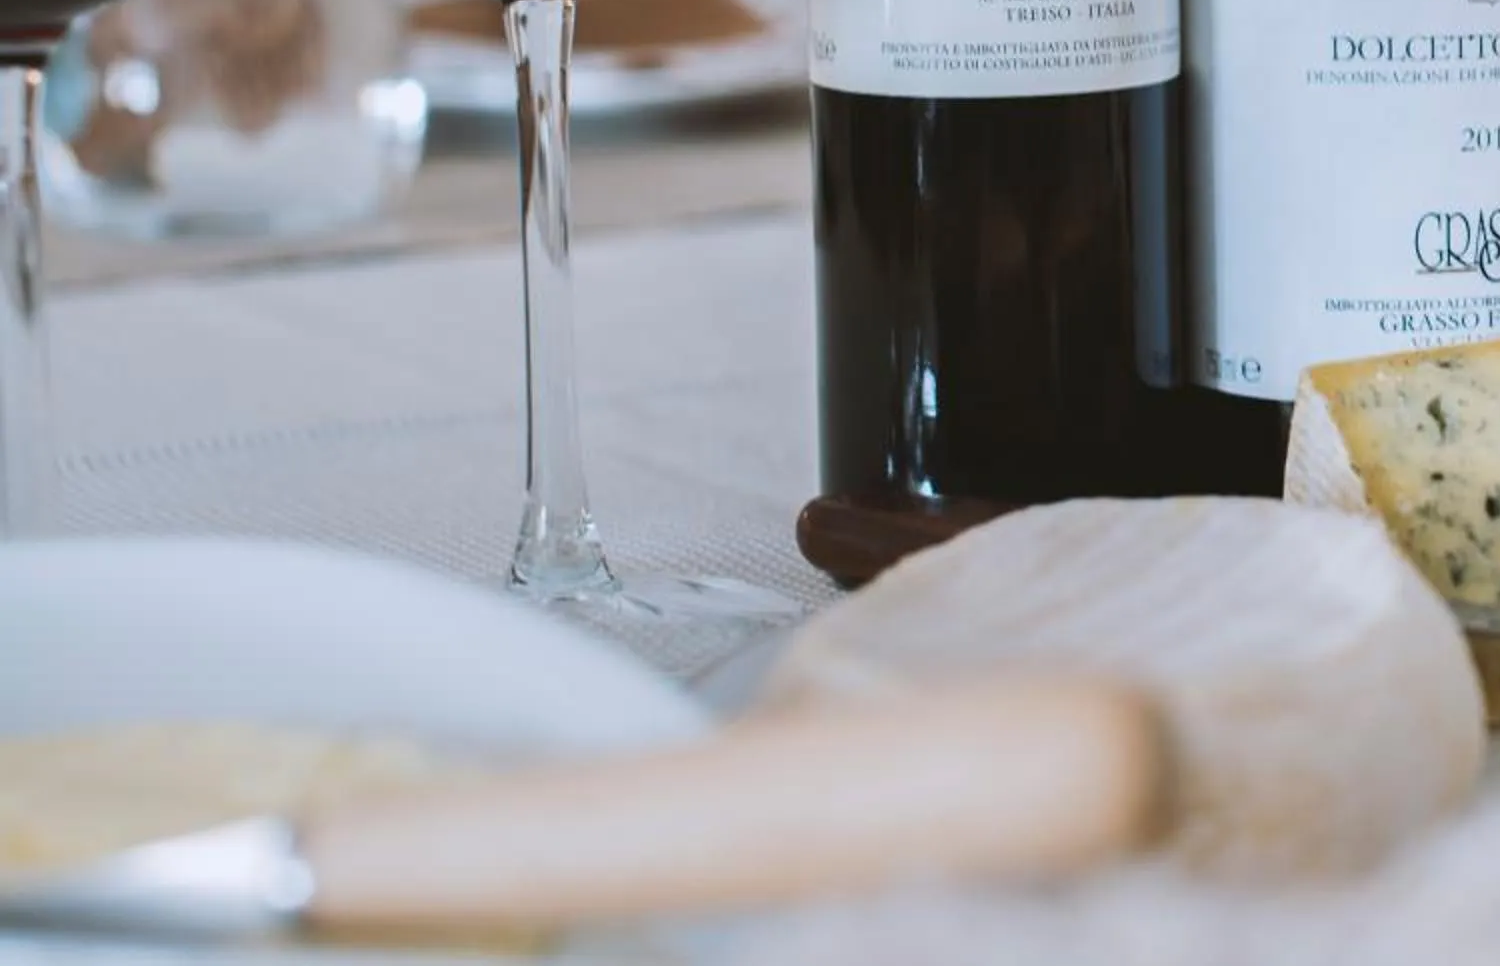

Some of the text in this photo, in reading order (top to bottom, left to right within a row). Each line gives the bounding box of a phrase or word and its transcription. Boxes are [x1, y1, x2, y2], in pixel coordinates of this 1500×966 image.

[1006, 5, 1072, 23] TREISO
[1088, 0, 1137, 21] ITALIA
[1325, 297, 1441, 312] IMBOTTIGLIATO
[1379, 310, 1480, 332] GRASSO
